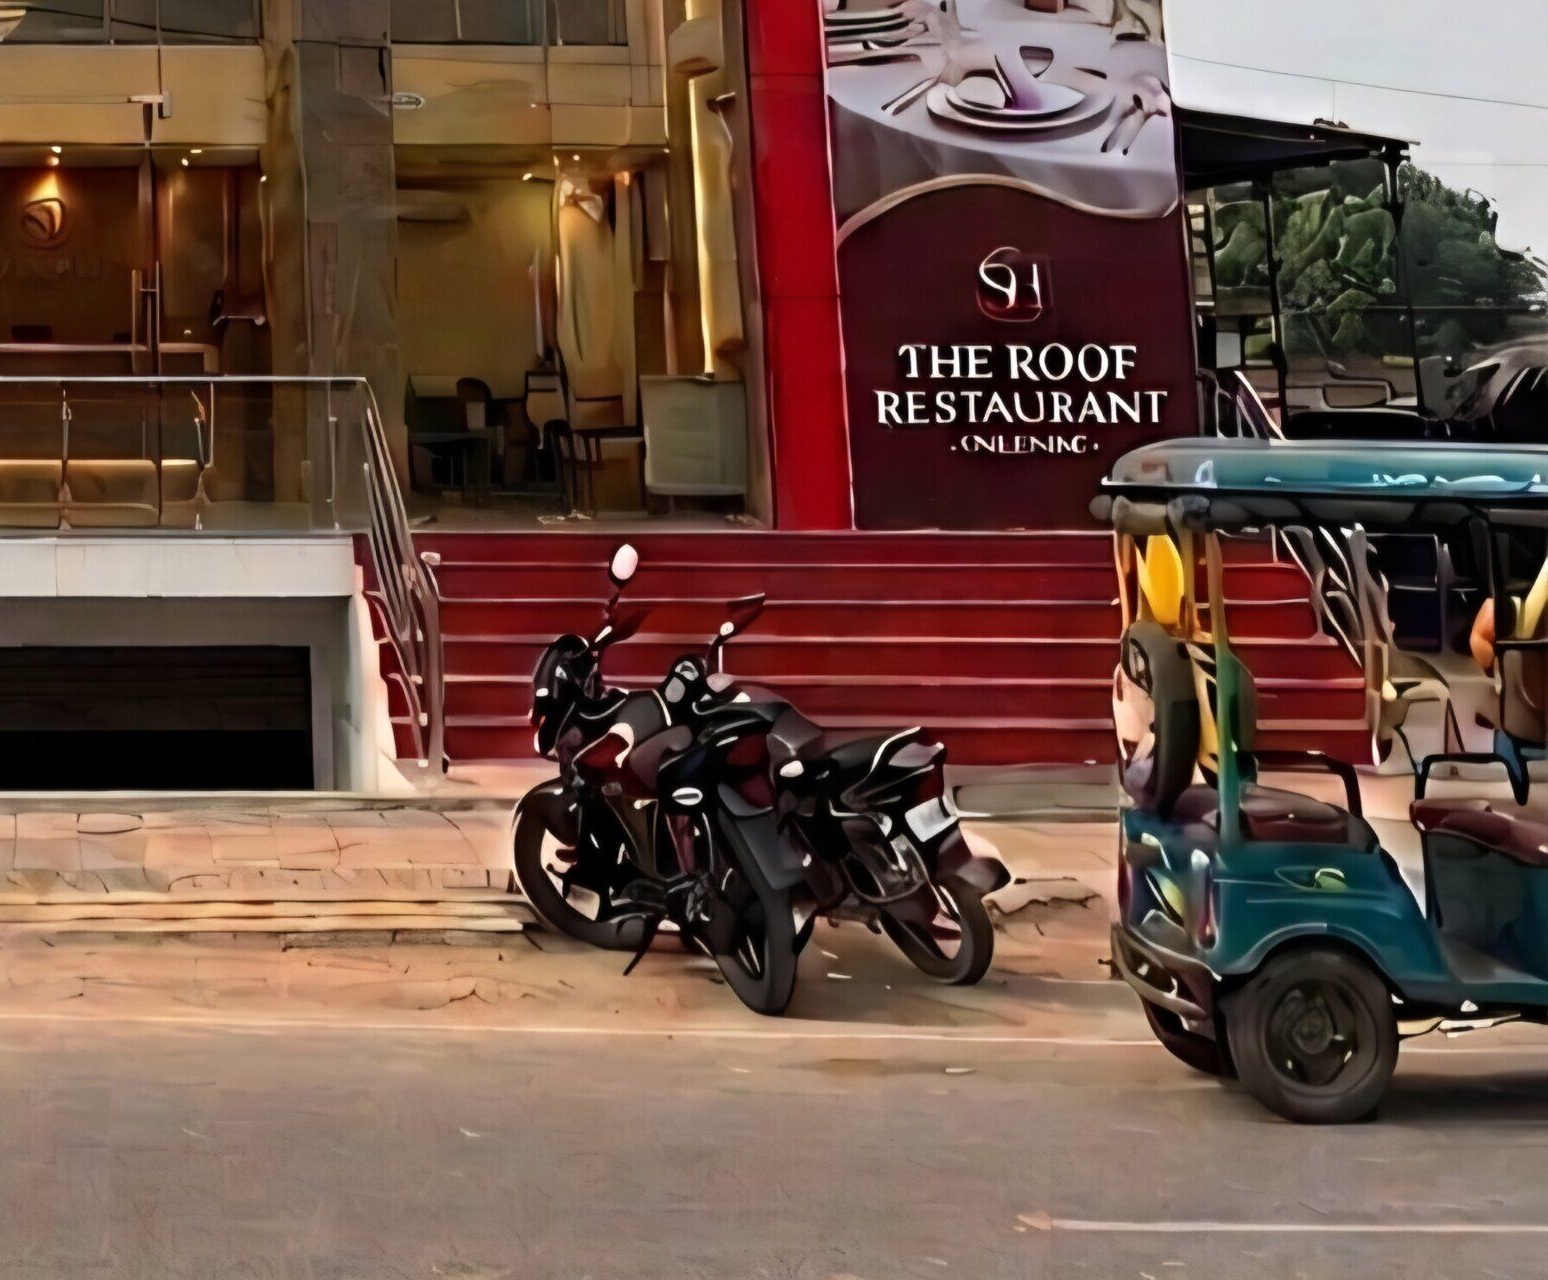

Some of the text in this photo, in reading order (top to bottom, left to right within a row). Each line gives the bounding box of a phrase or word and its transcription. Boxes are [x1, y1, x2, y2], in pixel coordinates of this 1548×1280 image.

[897, 341, 1138, 383] THE ROOF
[873, 388, 1169, 426] RESTAURANT
